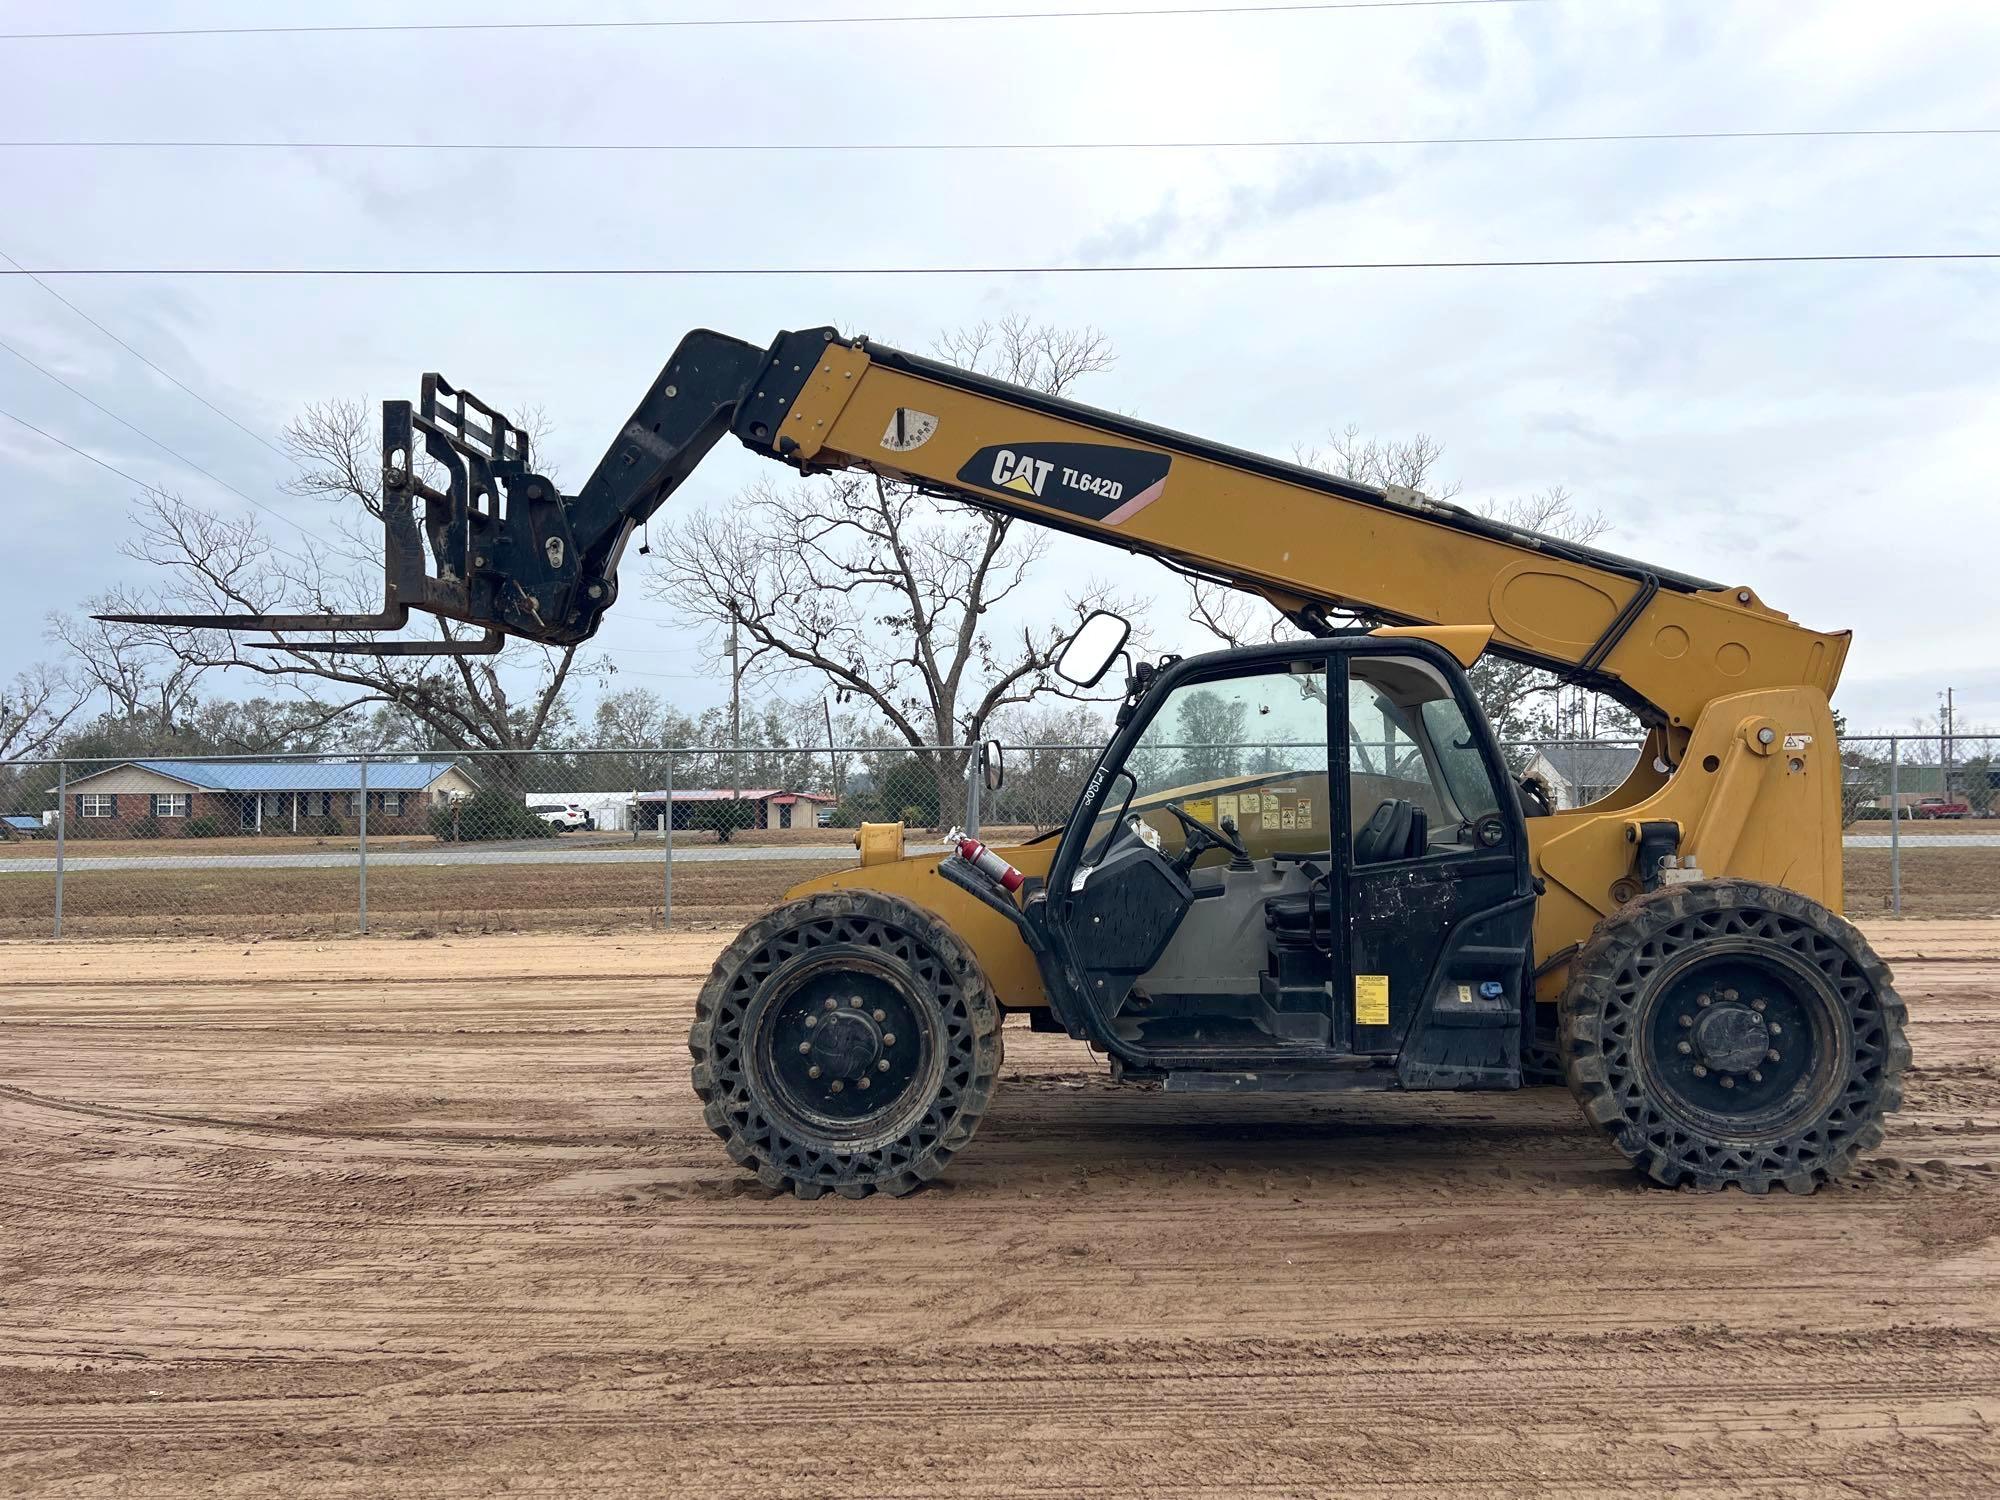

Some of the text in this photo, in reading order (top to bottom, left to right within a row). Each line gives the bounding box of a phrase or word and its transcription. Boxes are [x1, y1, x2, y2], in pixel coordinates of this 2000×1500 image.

[991, 449, 1124, 500] CAT TL642D
[1084, 766, 1110, 806] 208127
